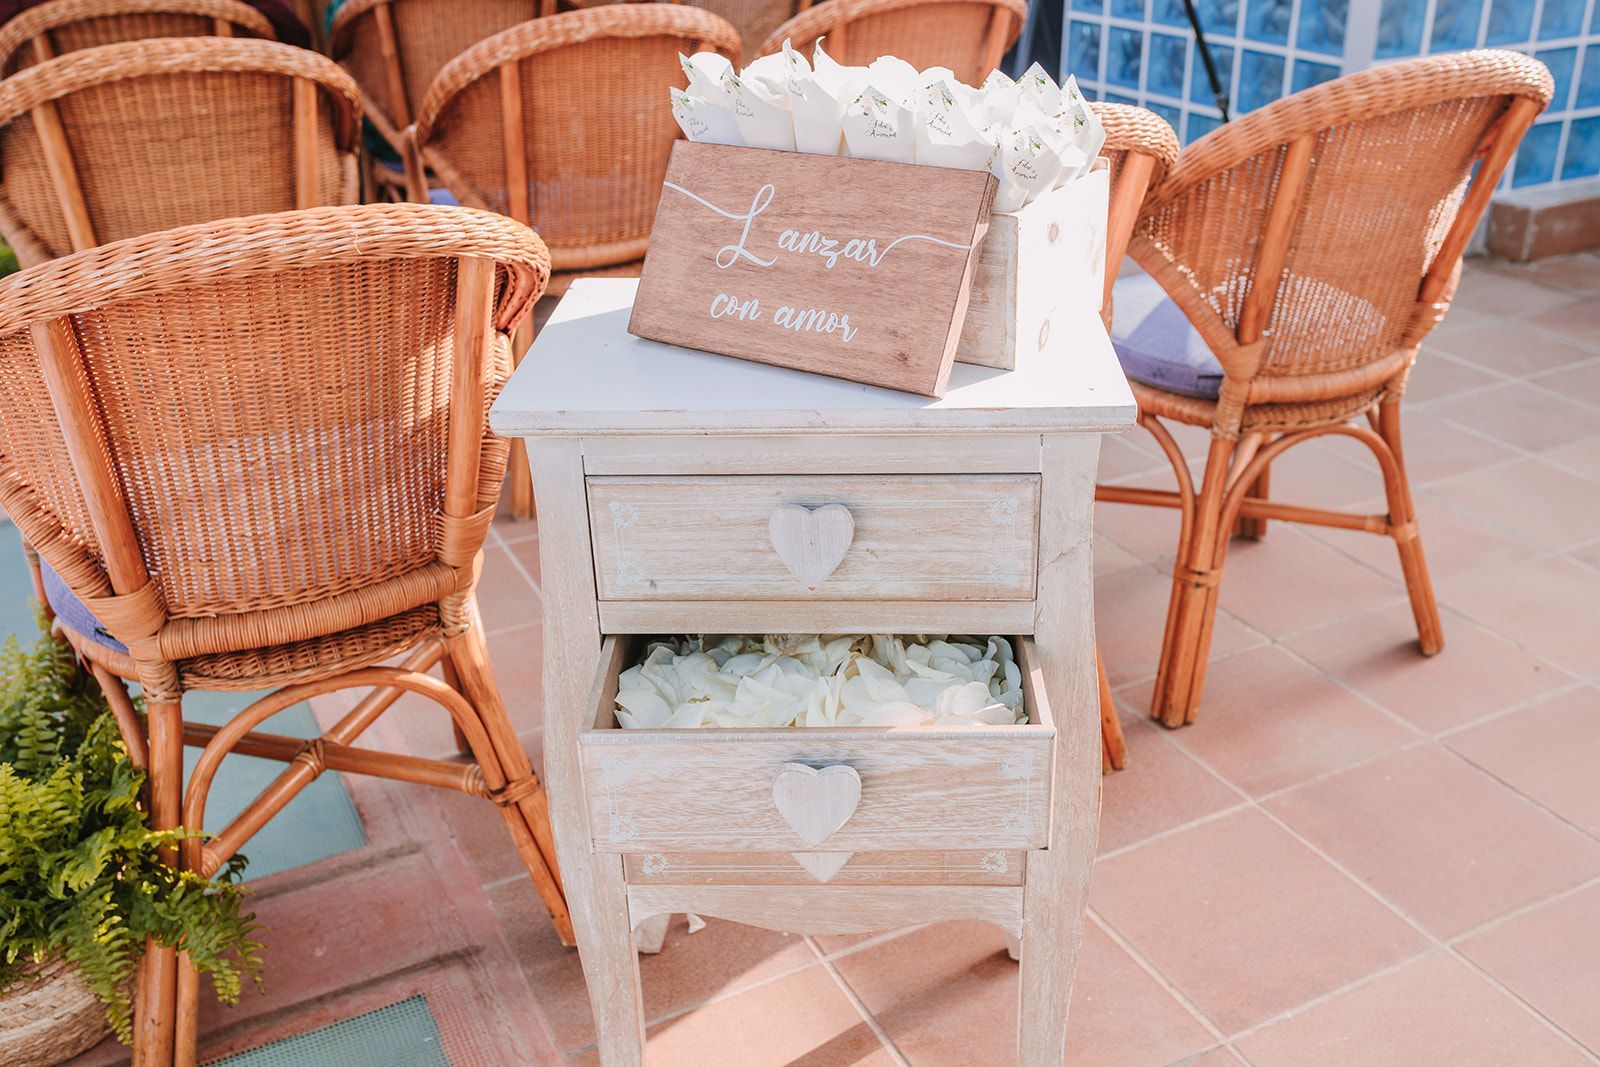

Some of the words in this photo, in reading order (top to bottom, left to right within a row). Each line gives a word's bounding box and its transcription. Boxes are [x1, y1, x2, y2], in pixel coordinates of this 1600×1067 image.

[714, 183, 890, 268] Lanzar
[709, 293, 762, 321] con
[773, 304, 859, 342] amor
